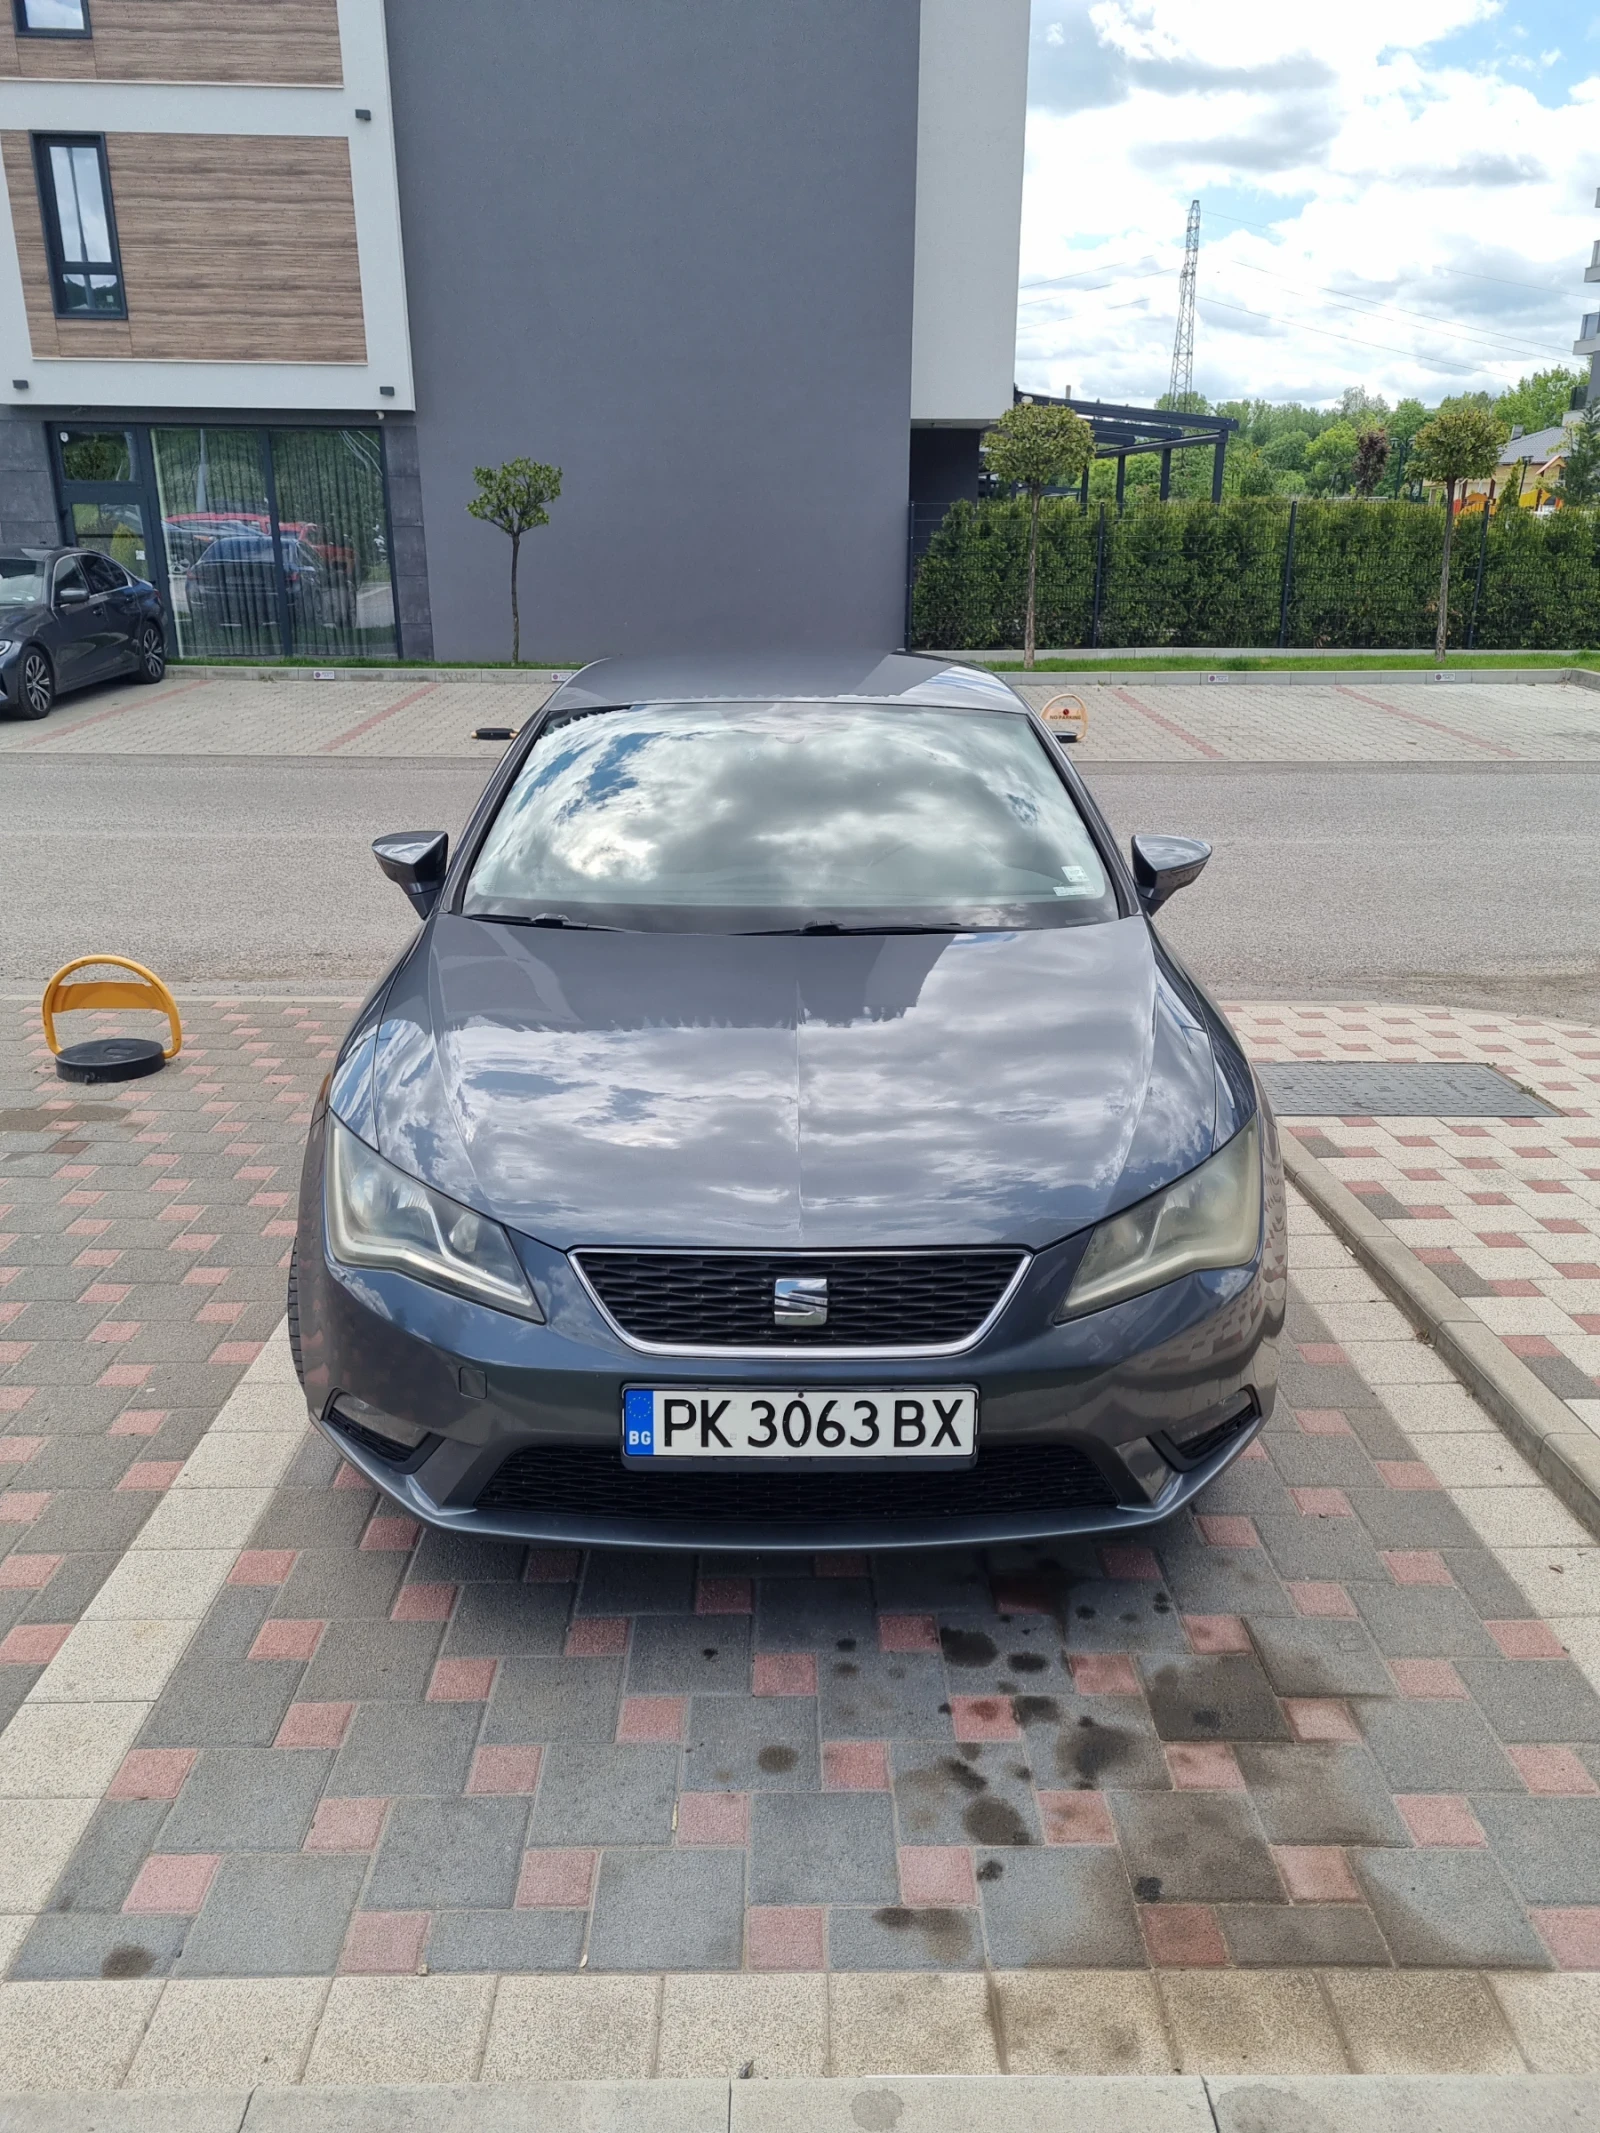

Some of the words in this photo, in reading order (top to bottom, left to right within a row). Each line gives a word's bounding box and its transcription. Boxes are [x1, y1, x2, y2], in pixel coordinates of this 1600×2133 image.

[628, 1430, 651, 1446] BG
[664, 1399, 733, 1448] PK
[747, 1399, 880, 1448] 3063
[893, 1399, 964, 1448] BX
